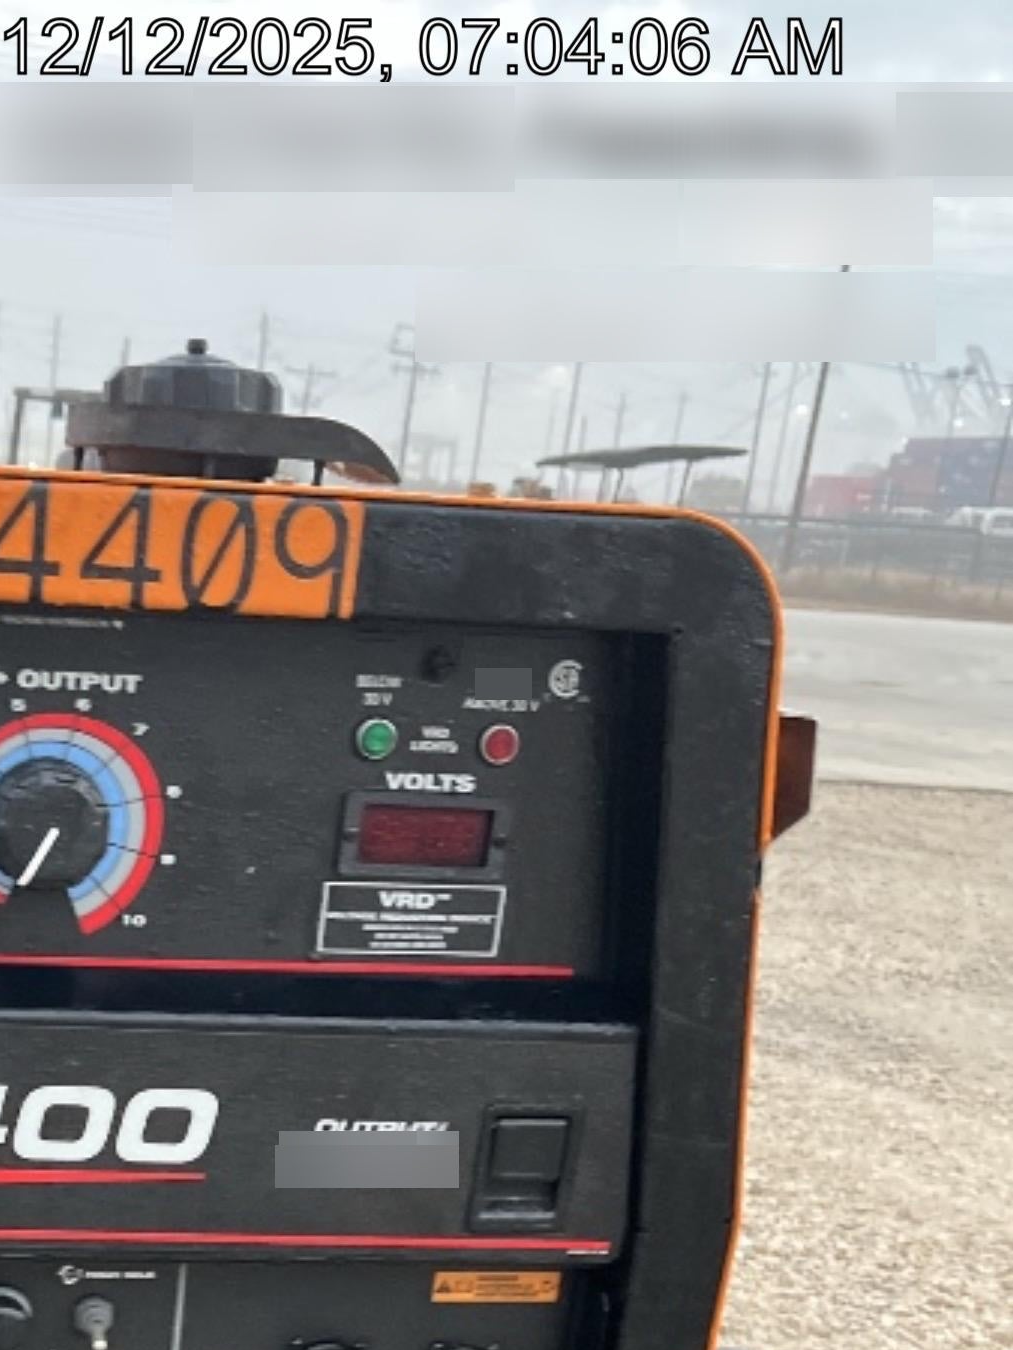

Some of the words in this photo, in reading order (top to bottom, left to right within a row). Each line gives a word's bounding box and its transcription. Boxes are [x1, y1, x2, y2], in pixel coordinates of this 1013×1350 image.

[17, 671, 141, 694] OUTPUT
[386, 772, 476, 792] VOLTS
[121, 914, 147, 926] 10
